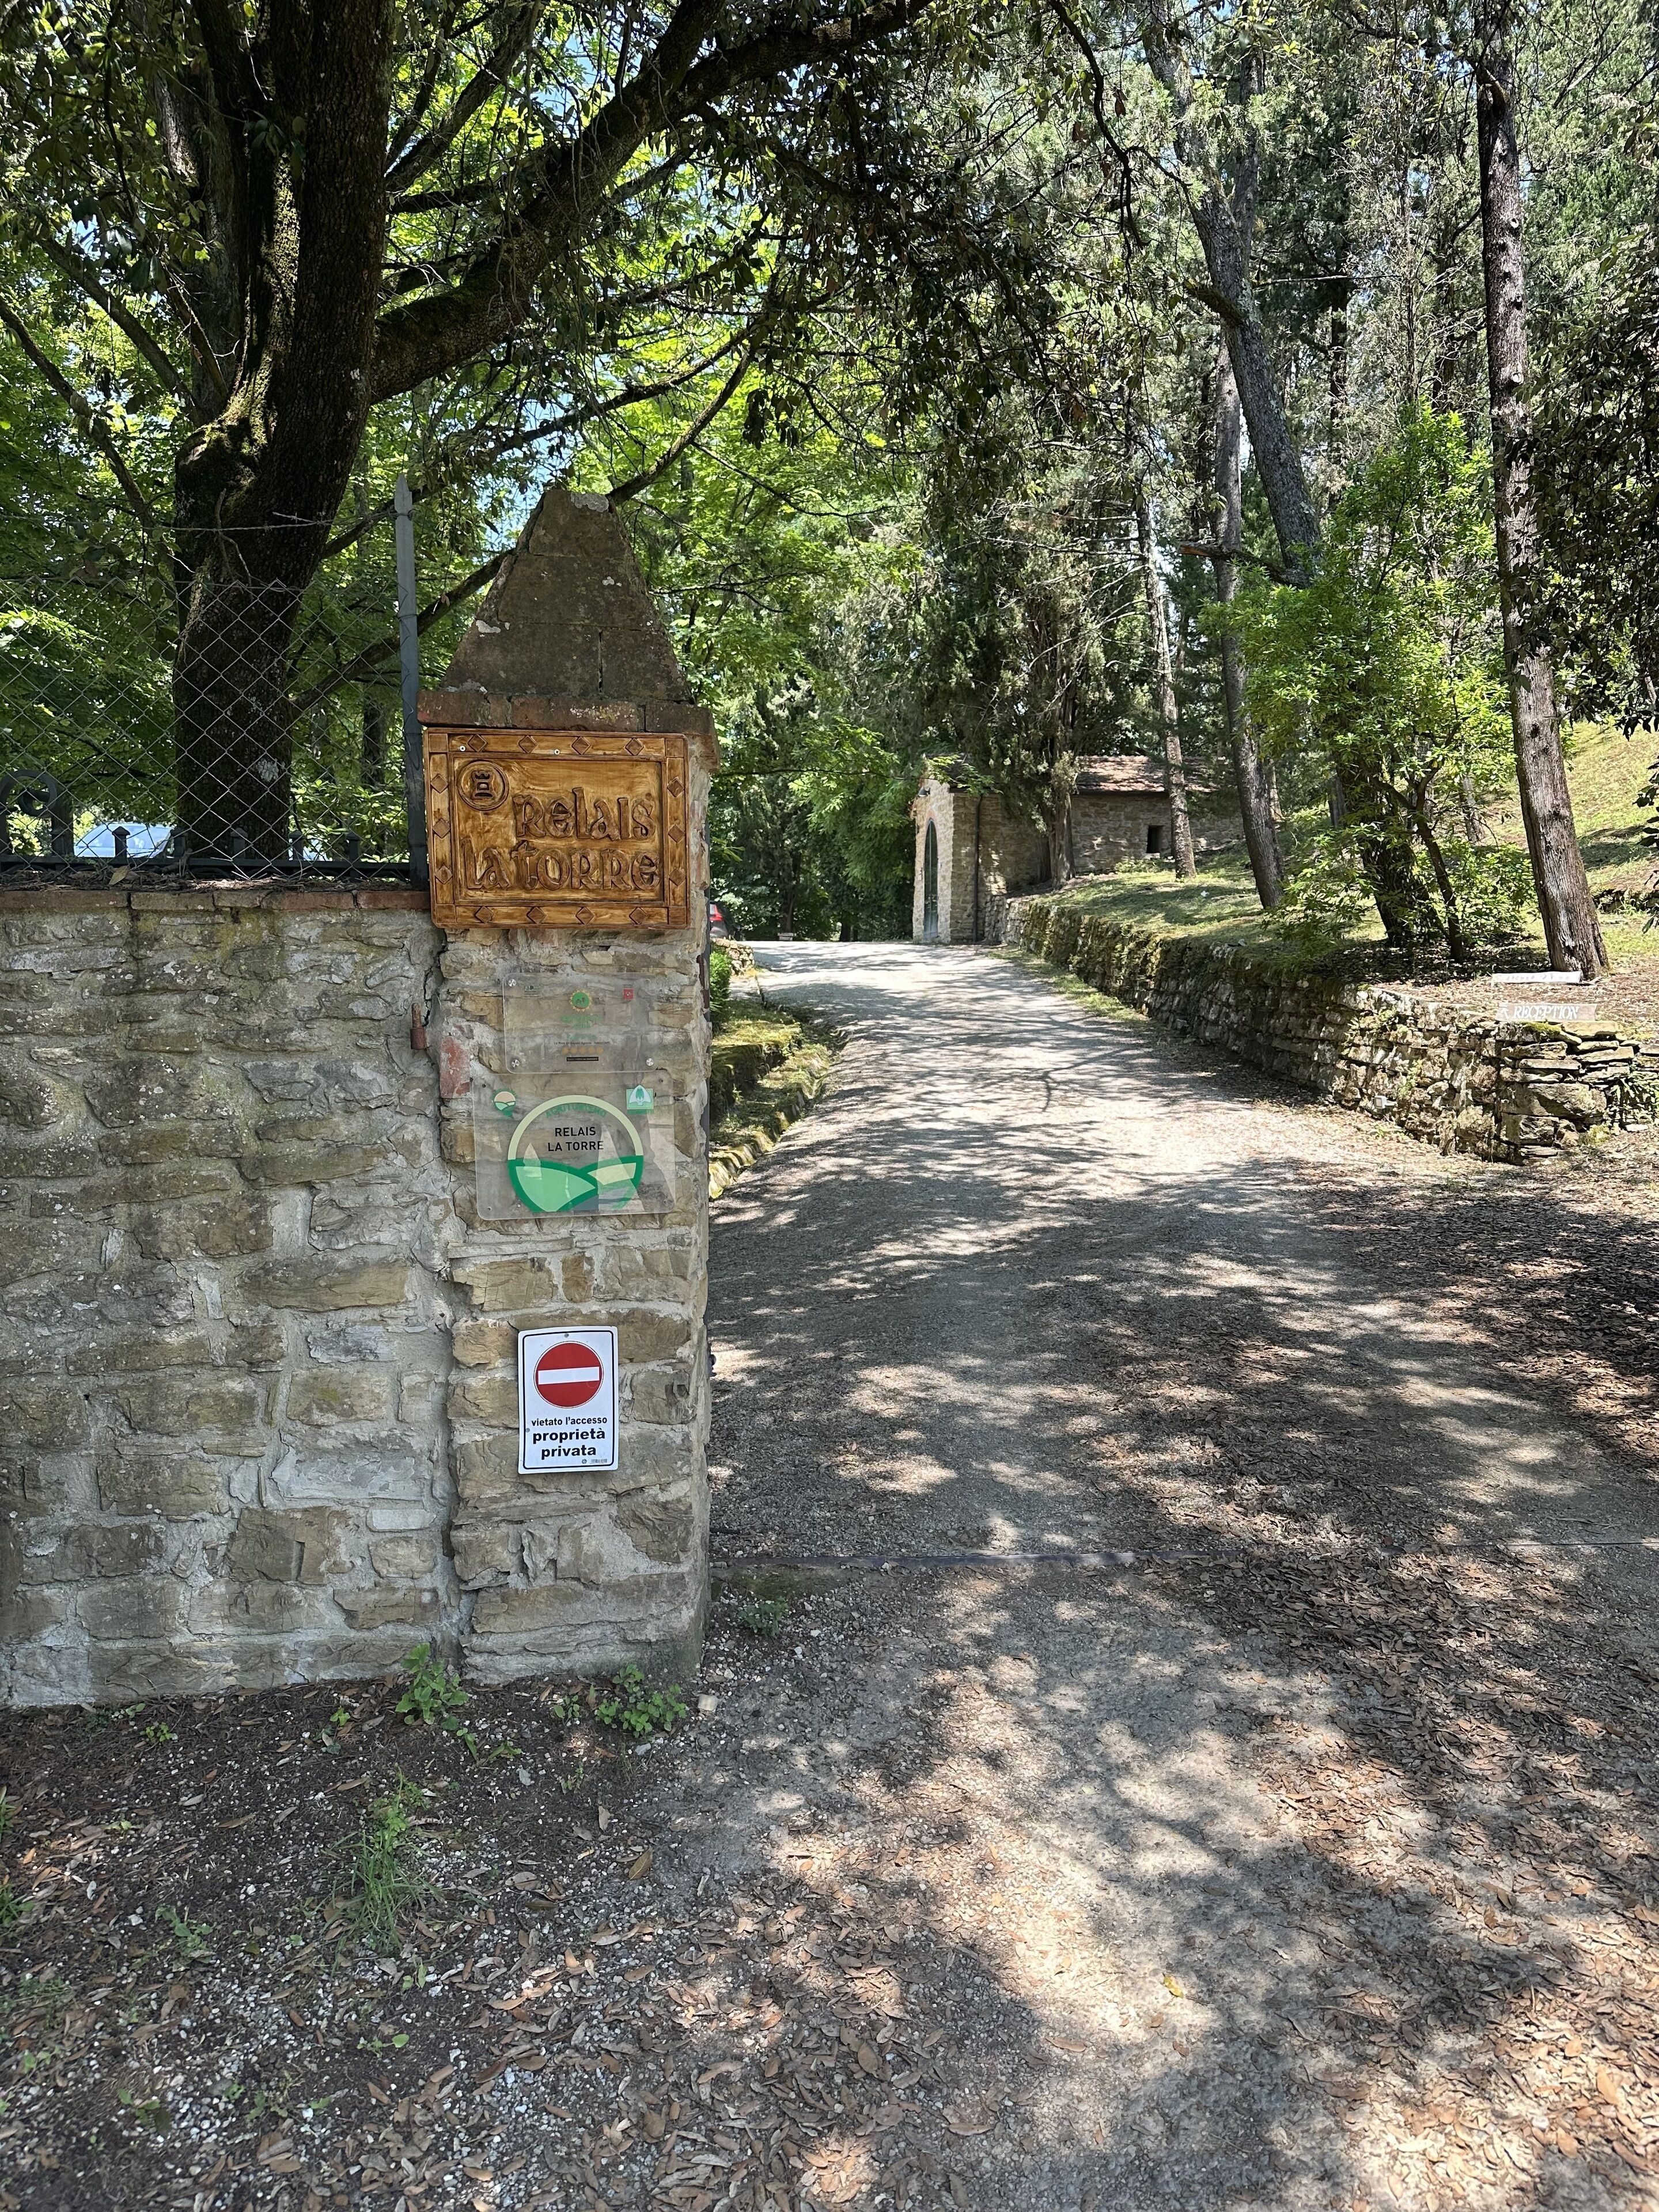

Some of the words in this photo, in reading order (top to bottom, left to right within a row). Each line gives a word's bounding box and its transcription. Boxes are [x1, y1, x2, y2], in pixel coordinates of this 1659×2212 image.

[1514, 1006, 1579, 1020] RECEPTION
[555, 1127, 596, 1137] RELAIS
[548, 1142, 563, 1152] LA
[566, 1141, 604, 1152] TORRE
[531, 1418, 563, 1426] vietato
[565, 1416, 607, 1425] l'accesso
[533, 1428, 605, 1444] proprietà
[541, 1445, 596, 1460] privata
